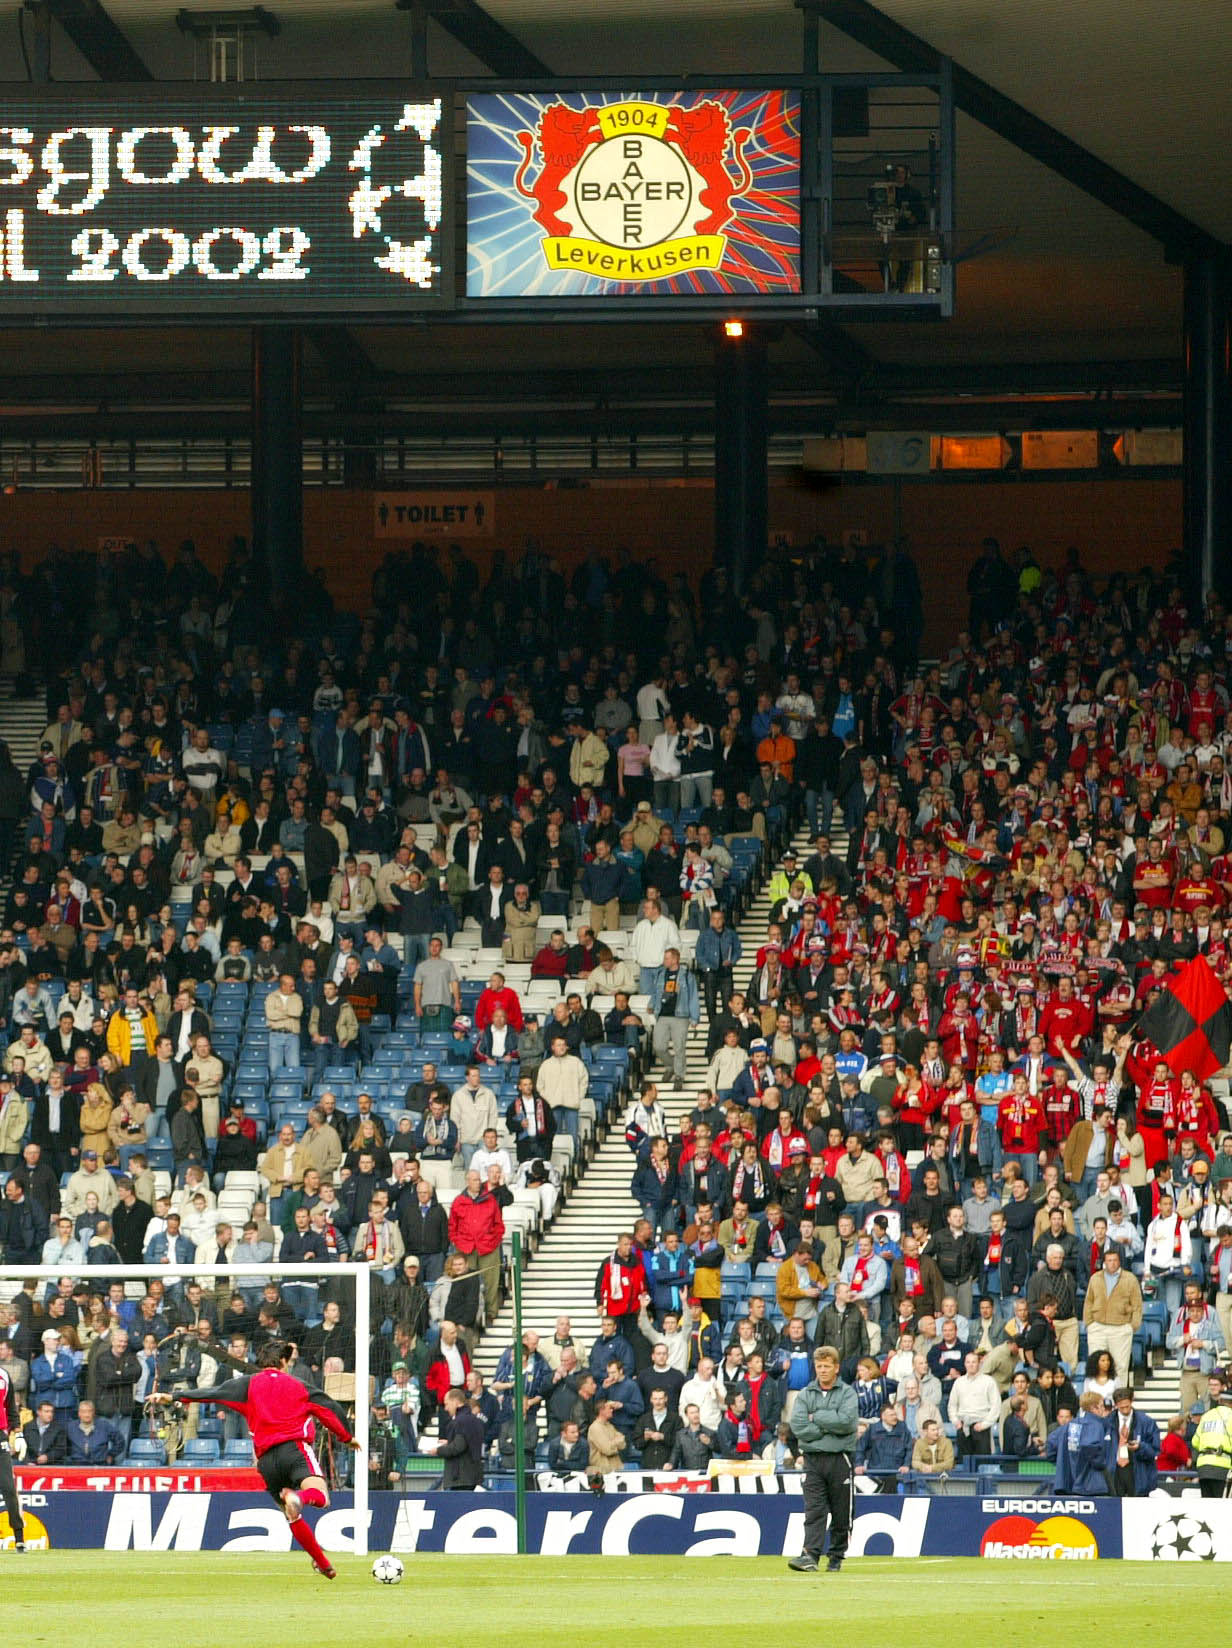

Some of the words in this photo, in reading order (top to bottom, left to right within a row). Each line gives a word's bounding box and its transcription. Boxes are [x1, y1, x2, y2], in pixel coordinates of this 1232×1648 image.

[607, 110, 659, 129] 1904
[581, 182, 685, 201] BAYER
[622, 140, 643, 244] BAYER
[66, 226, 311, 281] 2002
[555, 242, 710, 274] Leverkusen
[394, 505, 469, 523] TOILET
[984, 1541, 1095, 1559] MasterCard
